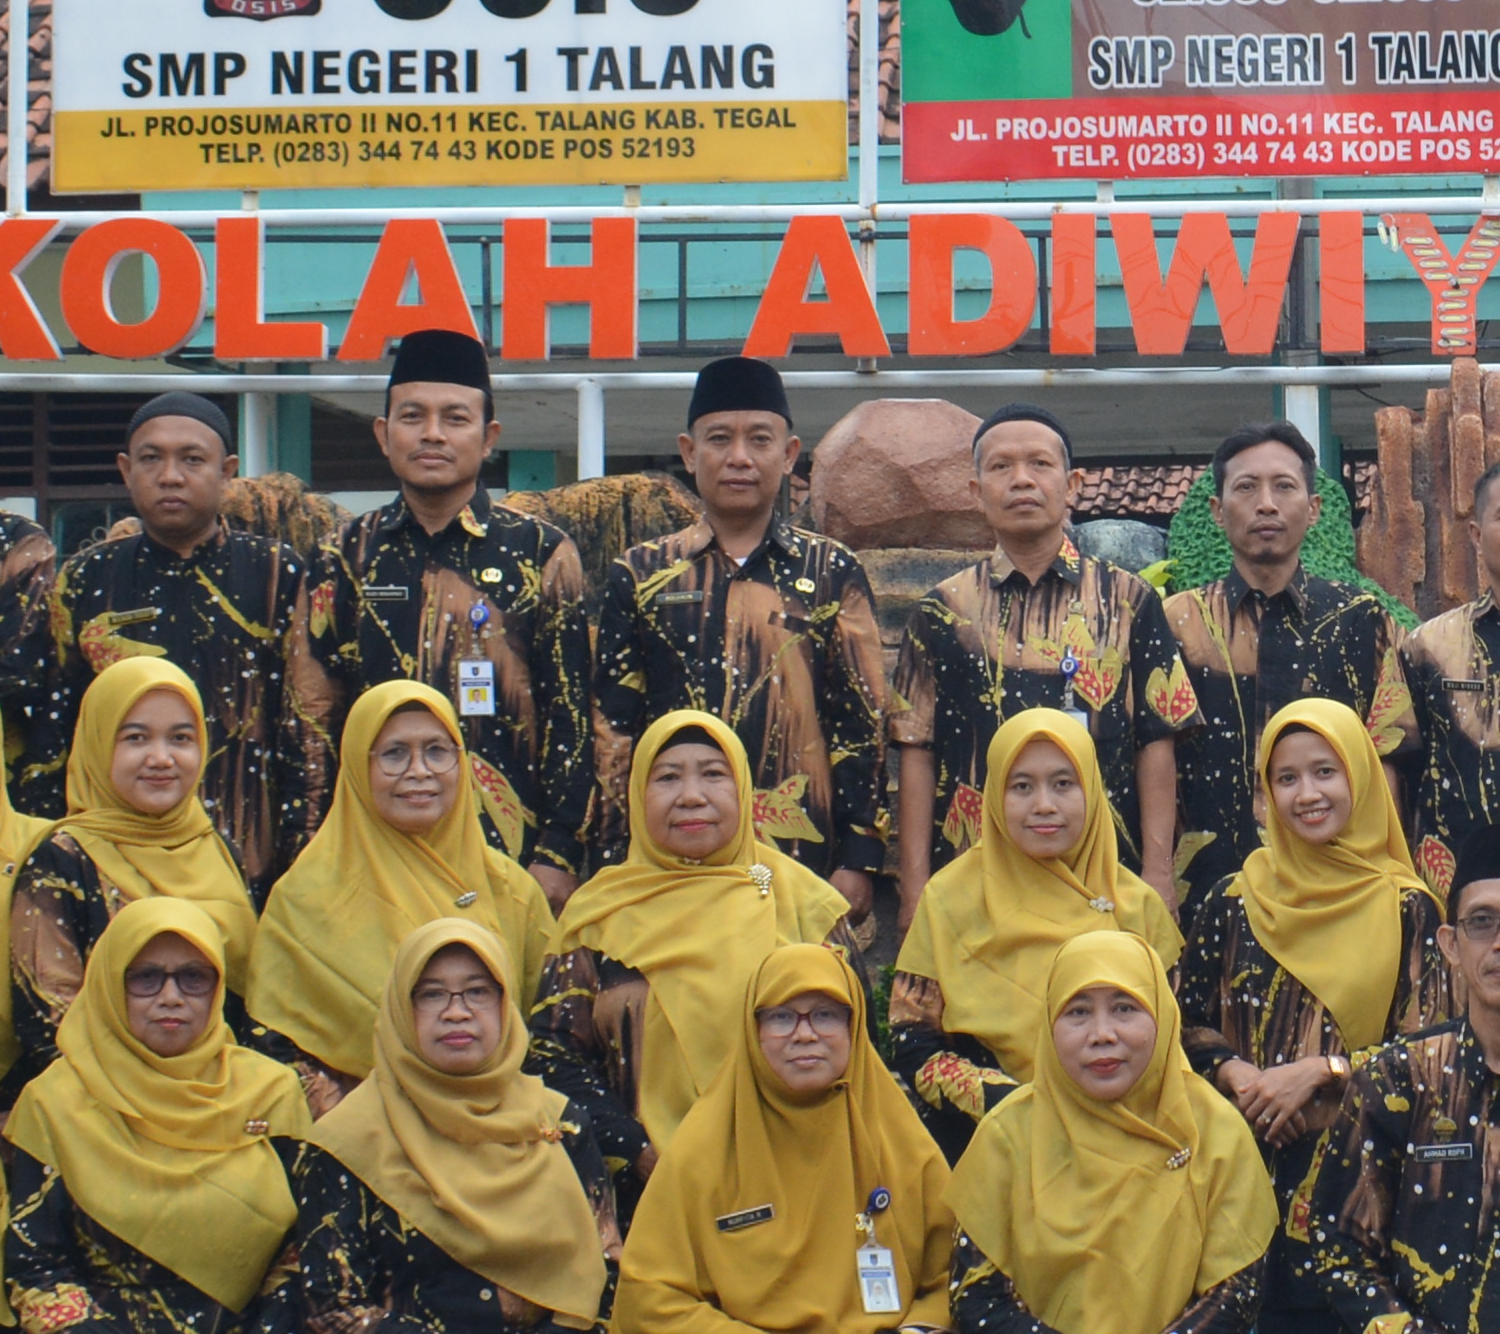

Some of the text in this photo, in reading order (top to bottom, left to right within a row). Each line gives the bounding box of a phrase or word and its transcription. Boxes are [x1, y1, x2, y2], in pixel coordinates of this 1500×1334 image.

[123, 44, 774, 98] SMP NEGERI 1 TALANG
[1089, 37, 1172, 88] SMP
[1186, 35, 1326, 86] NEGERI
[1339, 34, 1356, 83] 1
[200, 137, 694, 167] TELP. (0283) 344 74 43 KODE POS 52193
